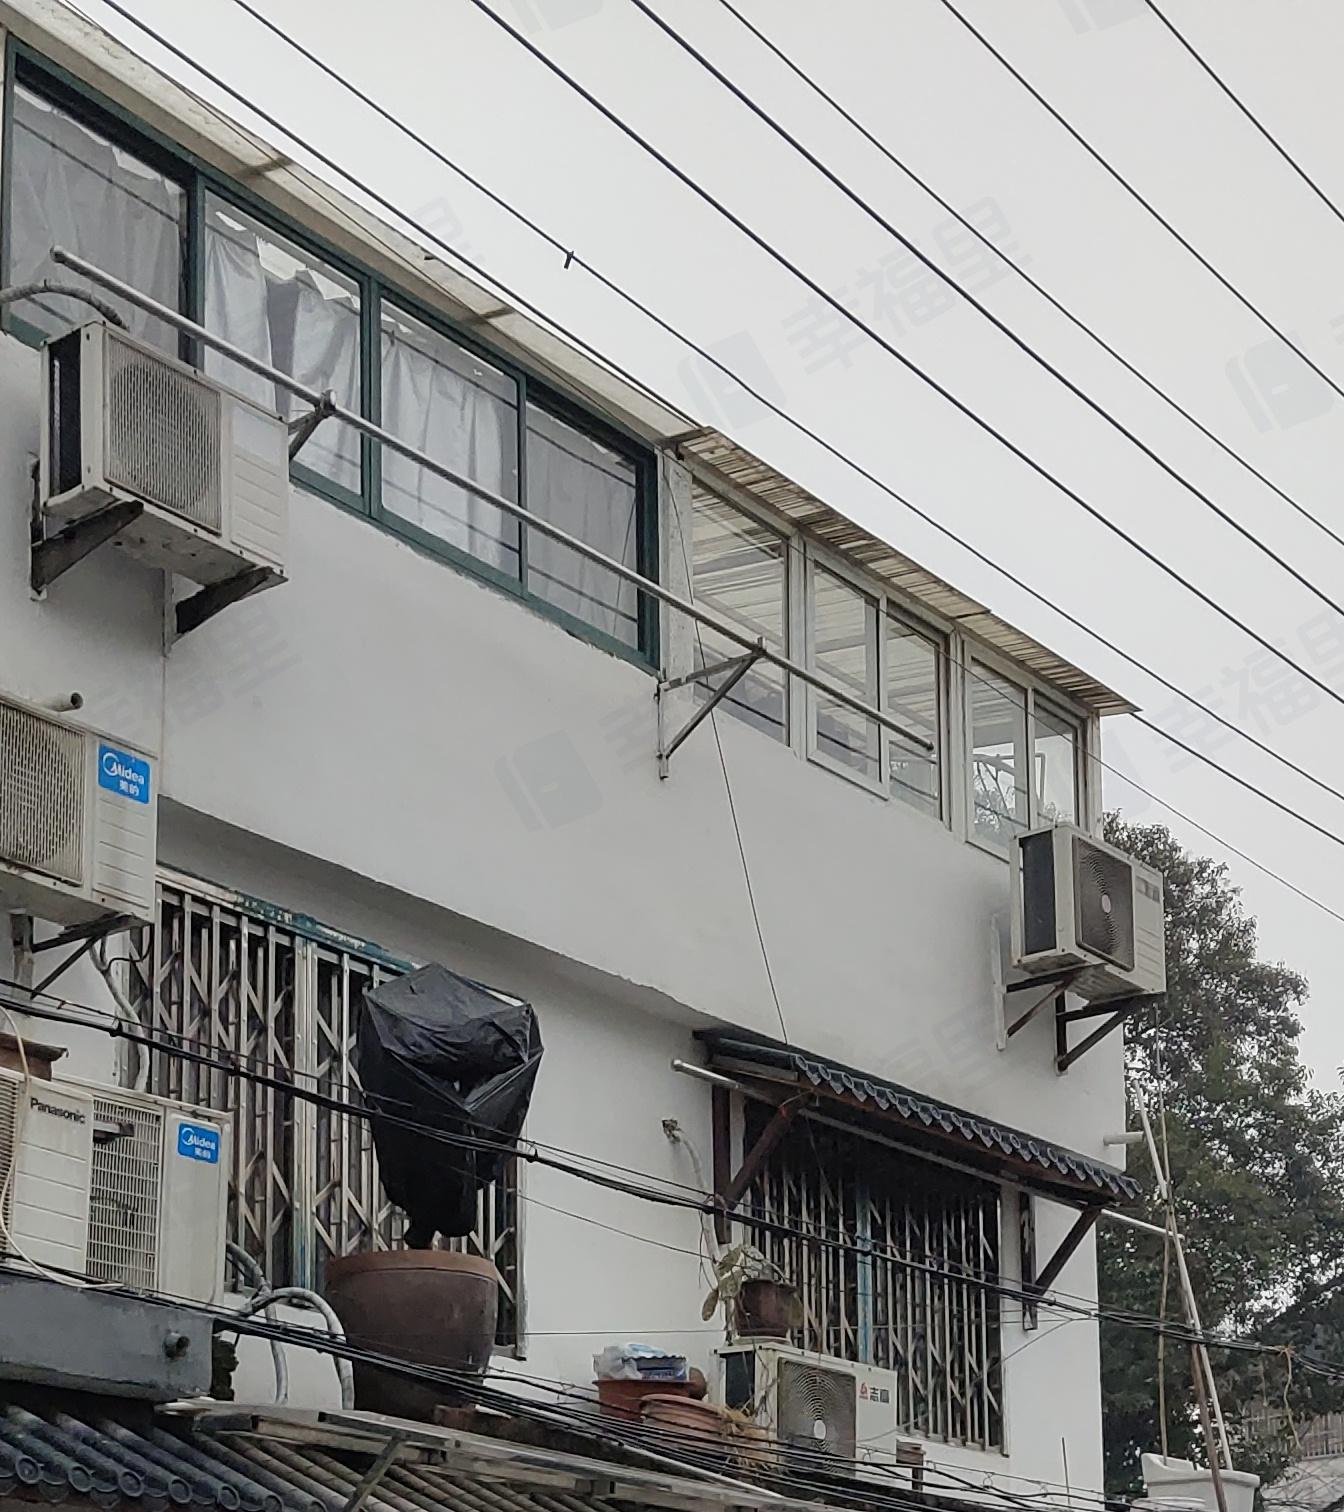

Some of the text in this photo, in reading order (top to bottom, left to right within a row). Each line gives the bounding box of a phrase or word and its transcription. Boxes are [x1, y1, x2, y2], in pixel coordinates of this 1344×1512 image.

[102, 752, 145, 786] Midea
[30, 1096, 86, 1125] Panasonic
[181, 1127, 216, 1151] Midea
